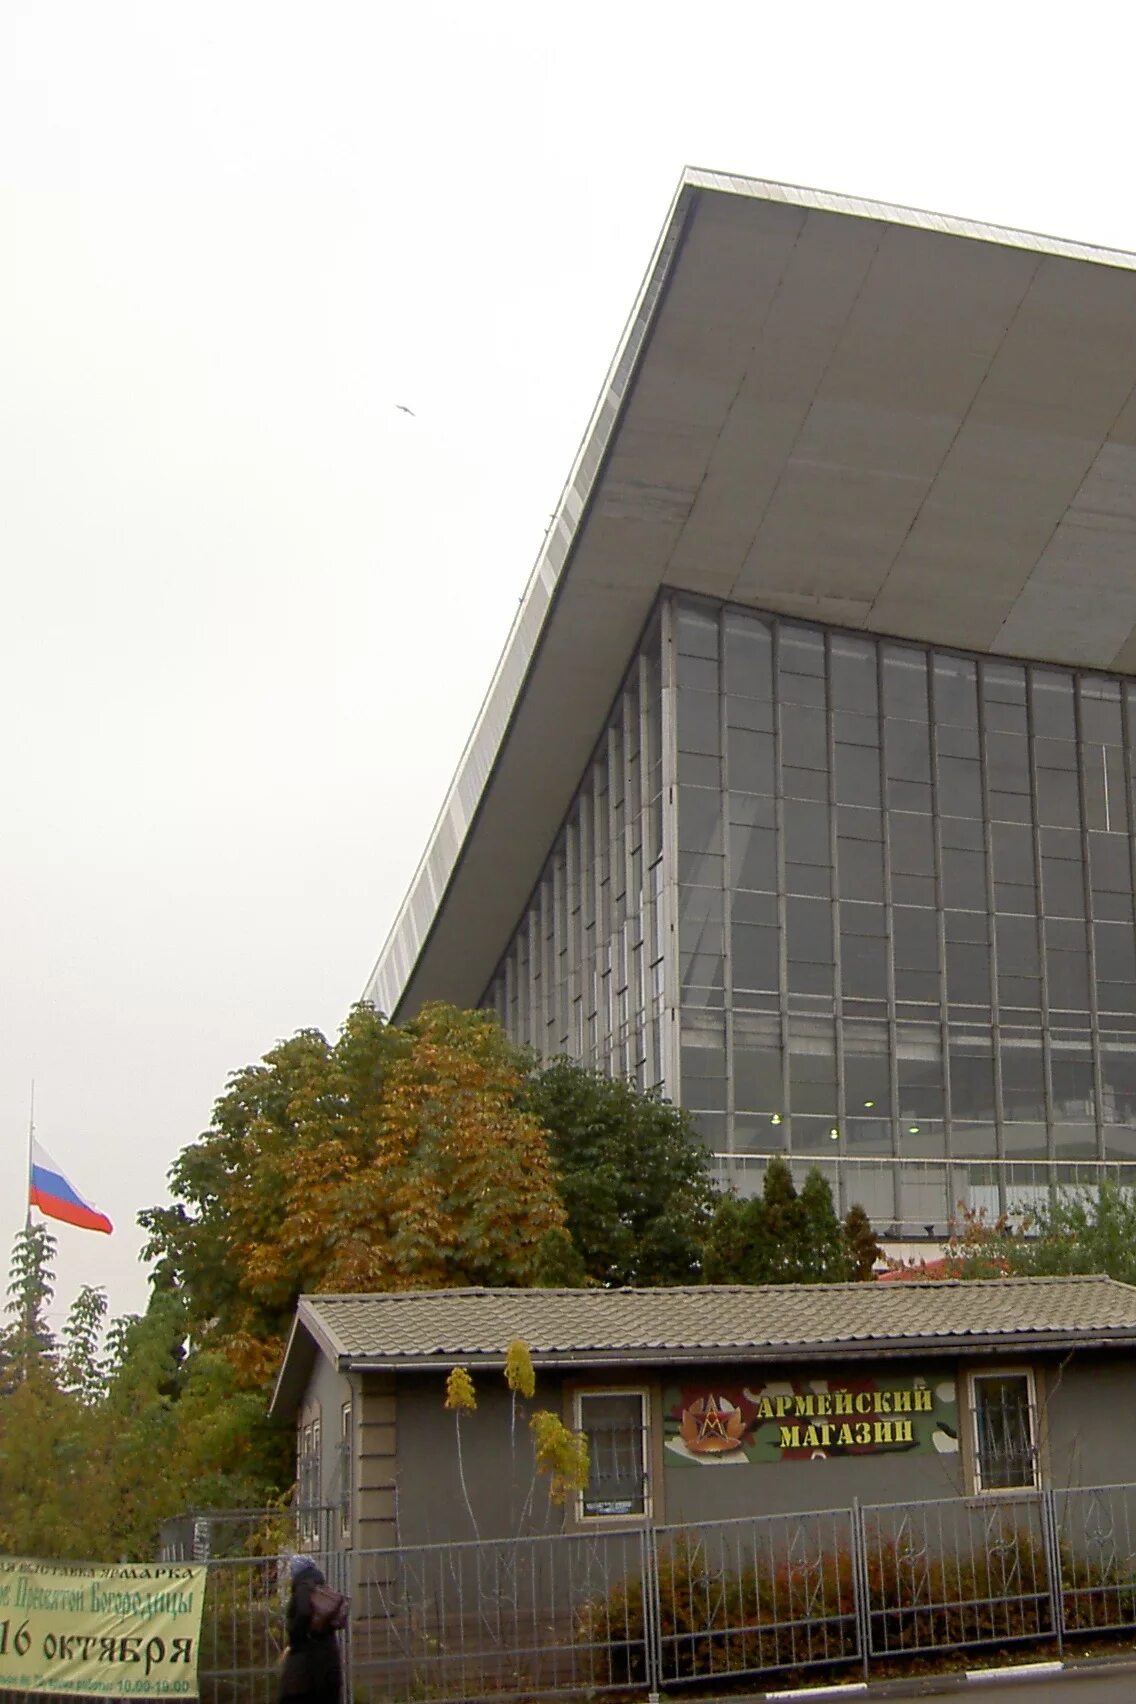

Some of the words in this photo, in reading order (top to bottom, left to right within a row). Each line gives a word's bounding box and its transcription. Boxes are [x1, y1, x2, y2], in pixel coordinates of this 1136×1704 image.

[756, 1386, 933, 1418] АРМЕЙСКИЙ
[779, 1420, 914, 1448] МАГАЗИН
[101, 1567, 195, 1579] ЯРМАРКА
[0, 1619, 31, 1657] 16
[43, 1632, 193, 1676] октября
